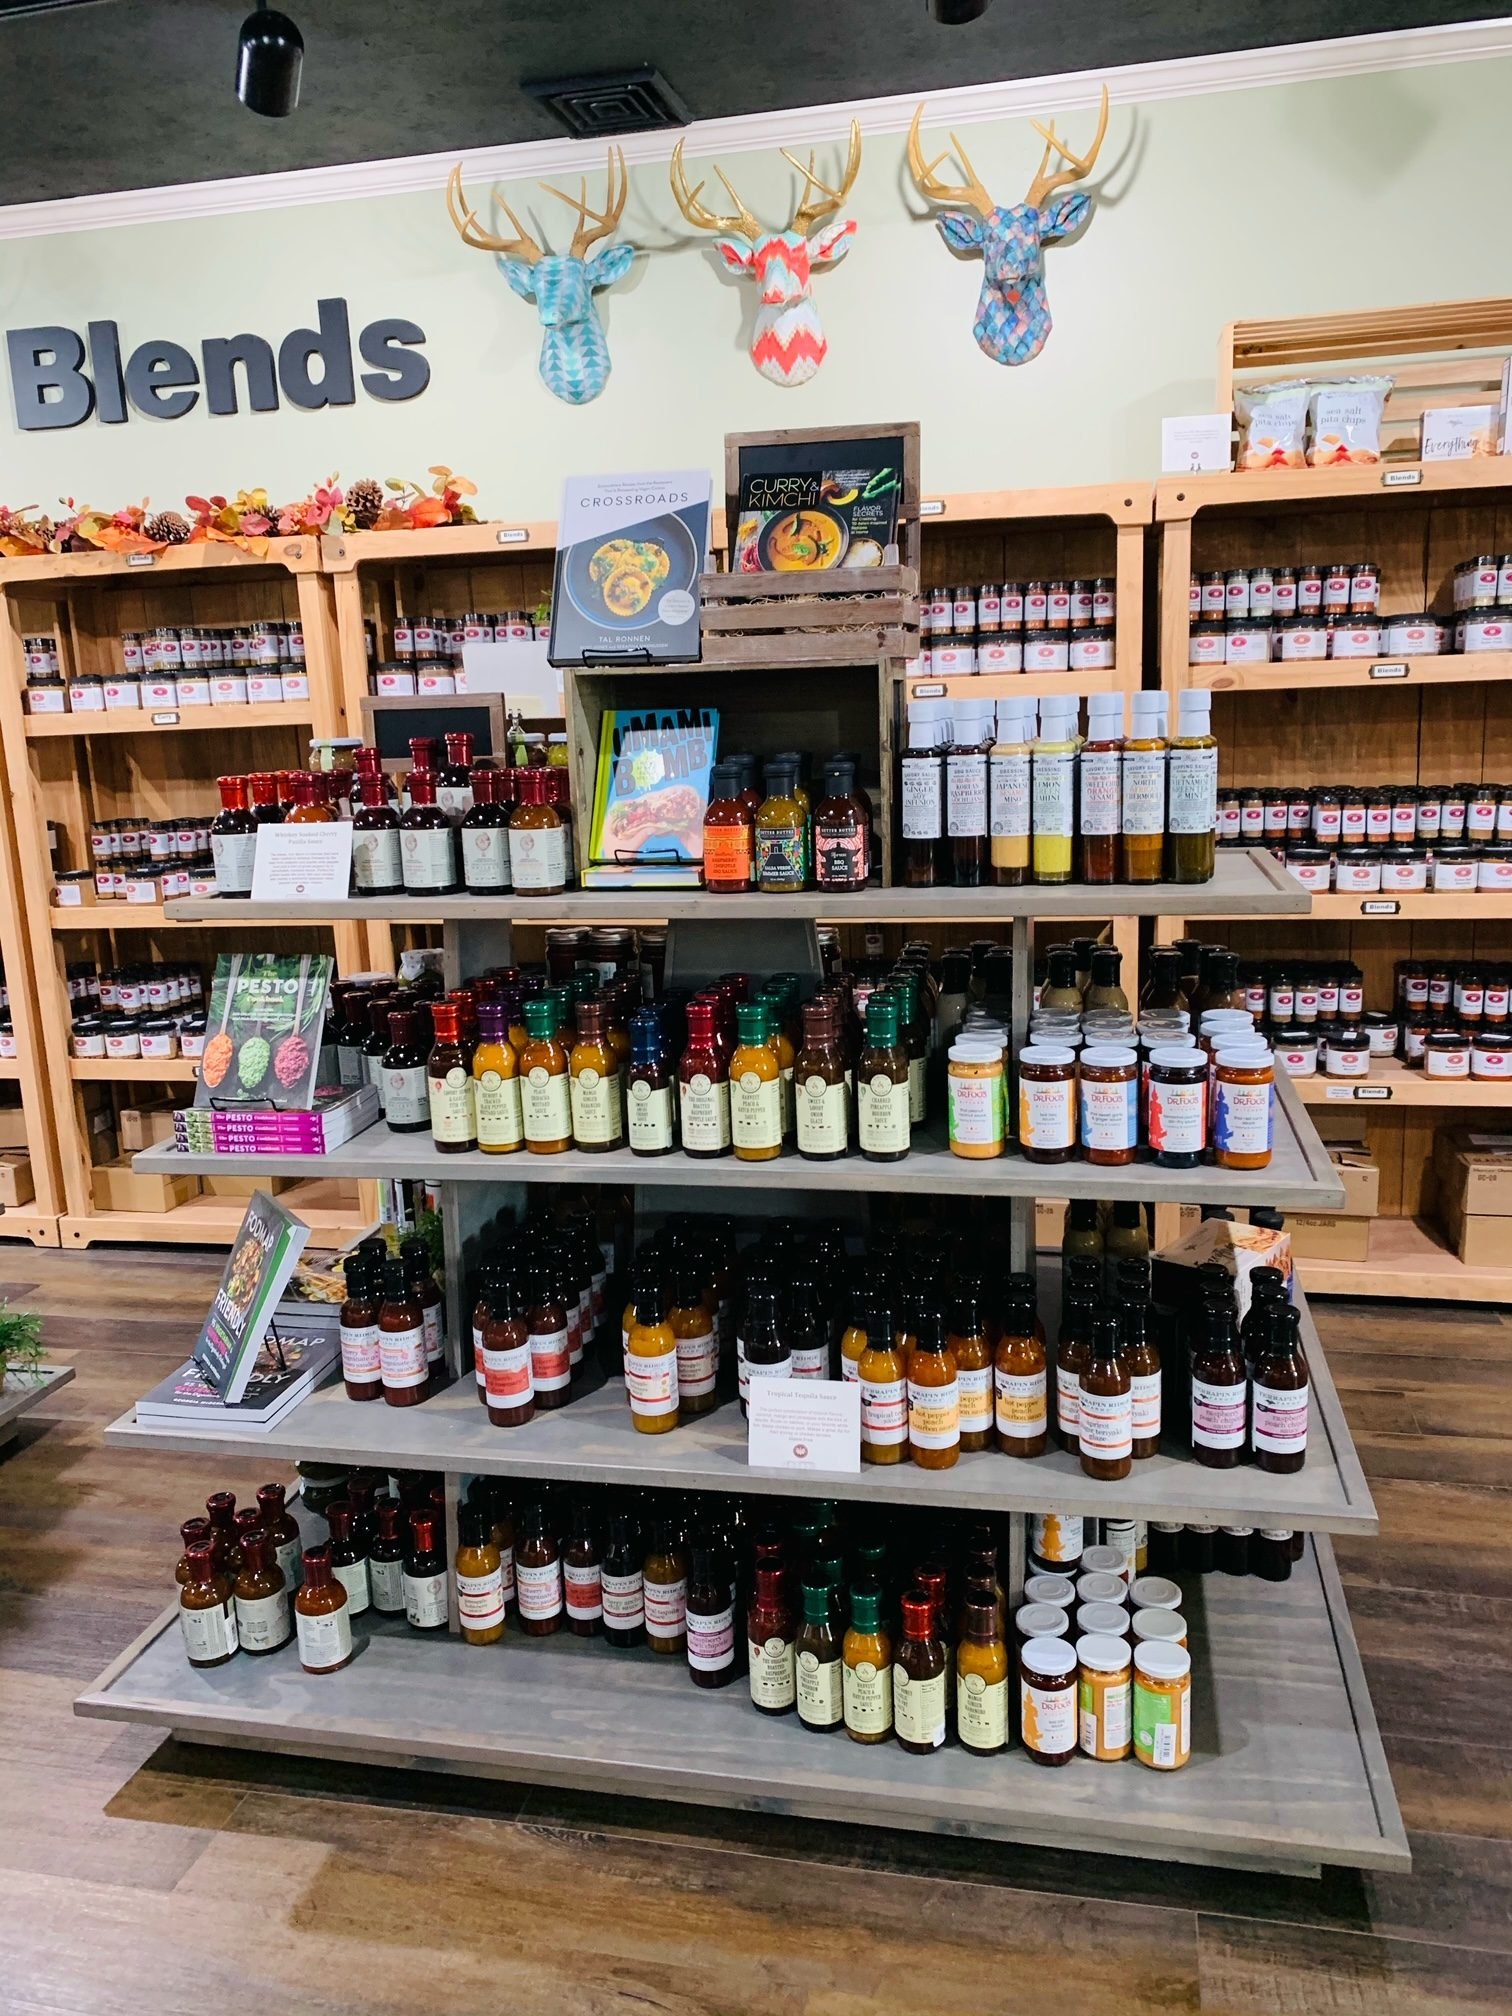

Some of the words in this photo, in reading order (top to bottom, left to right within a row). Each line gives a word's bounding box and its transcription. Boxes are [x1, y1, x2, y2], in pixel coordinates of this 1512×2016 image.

[6, 297, 430, 431] Blends
[1345, 406, 1362, 415] salt
[1321, 416, 1339, 424] pita
[1342, 415, 1367, 425] chips
[750, 477, 808, 494] CURRY
[580, 492, 689, 508] CROSSROADS
[748, 492, 816, 508] KIMCHI
[612, 709, 713, 757] UMAMI
[237, 978, 299, 994] PESTO
[225, 1113, 253, 1122] PESTO
[226, 1124, 254, 1132] PESTO
[228, 1134, 256, 1142] PESTO
[229, 1144, 257, 1153] PESTO
[246, 1210, 275, 1252] FODMAP
[214, 1287, 246, 1338] FRIENDLY
[767, 1390, 793, 1399] Tropical
[795, 1391, 818, 1399] Tequila
[867, 1410, 894, 1419] tropical
[927, 1411, 949, 1419] pepper
